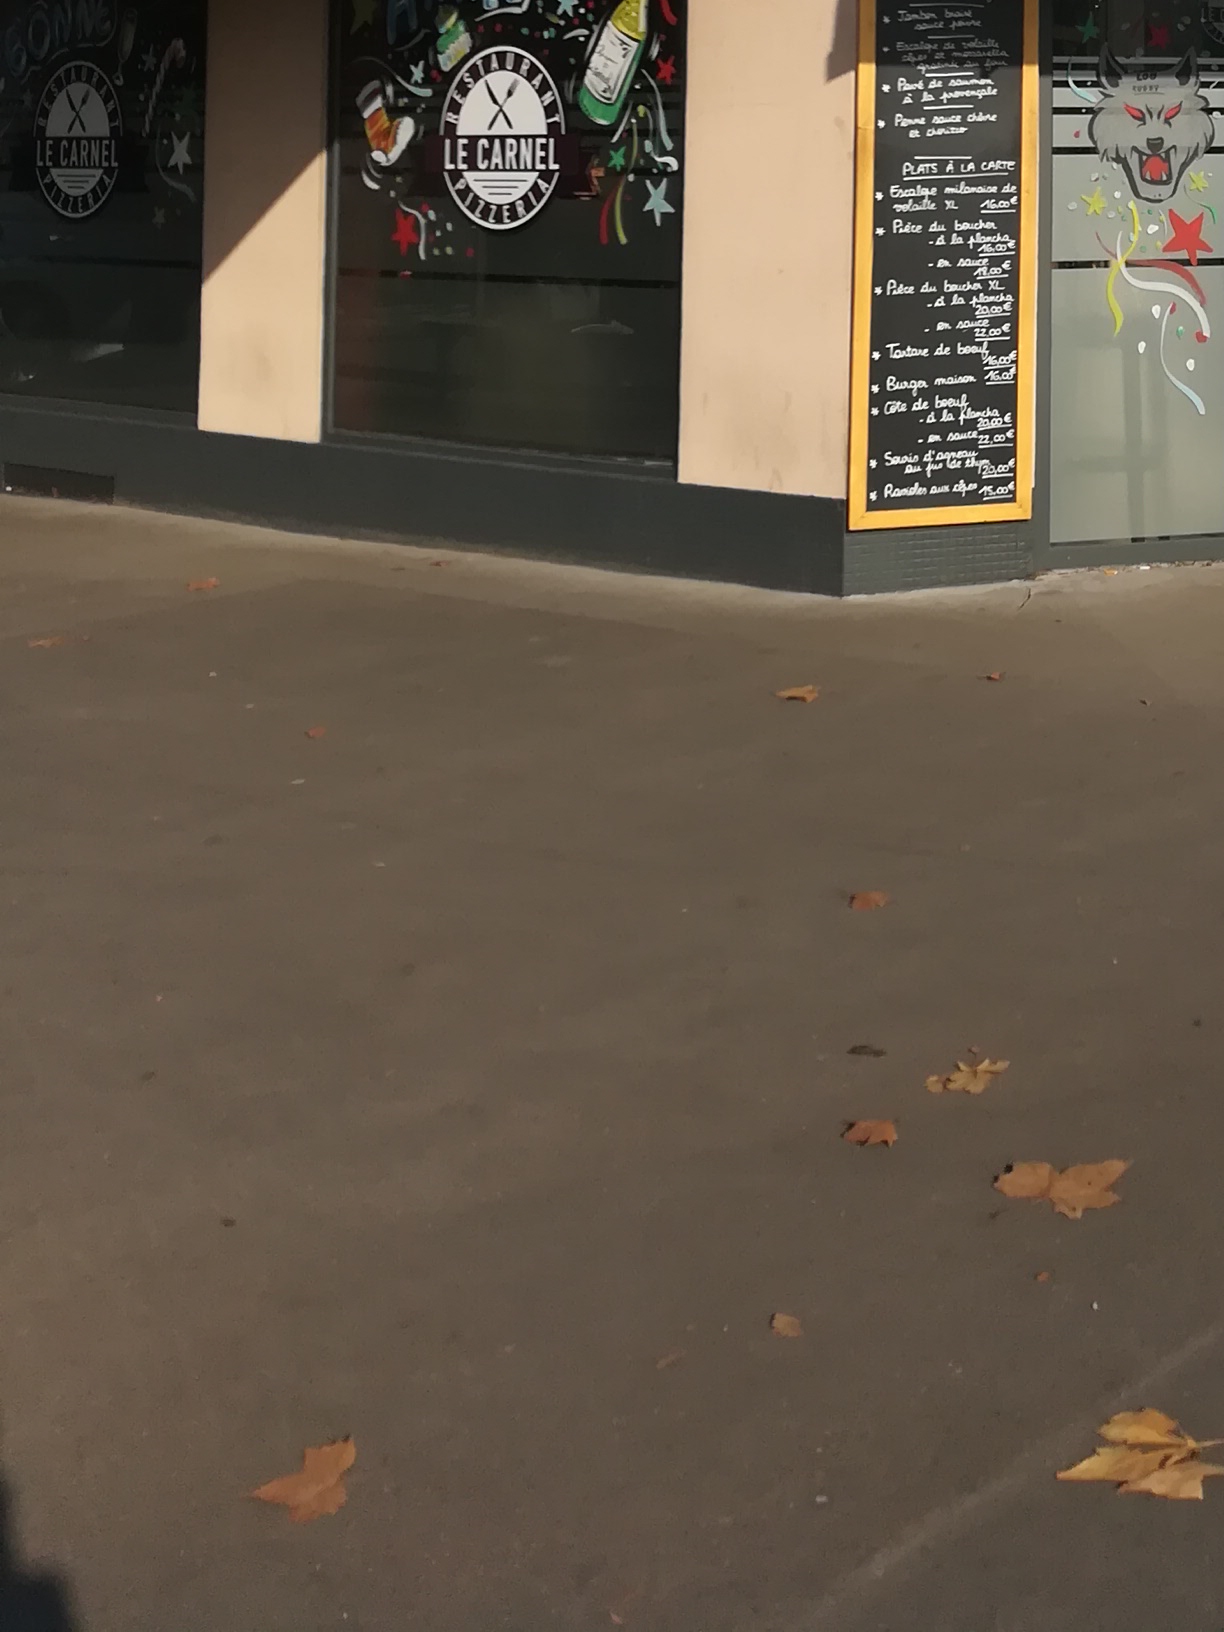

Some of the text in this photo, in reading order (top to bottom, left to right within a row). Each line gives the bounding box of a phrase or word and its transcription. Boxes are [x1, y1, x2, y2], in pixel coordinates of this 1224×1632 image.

[38, 66, 120, 129] RESTAURANT
[446, 52, 561, 126] RESTAURANT
[37, 140, 118, 167] LE CARNEL
[444, 138, 560, 170] LE CARNEL
[902, 162, 938, 176] PLATS
[961, 162, 975, 172] LA
[981, 161, 1016, 171] CARTE
[43, 170, 112, 213] PIZZERIA
[454, 178, 551, 224] PIZZERIA
[886, 376, 929, 397] Burger
